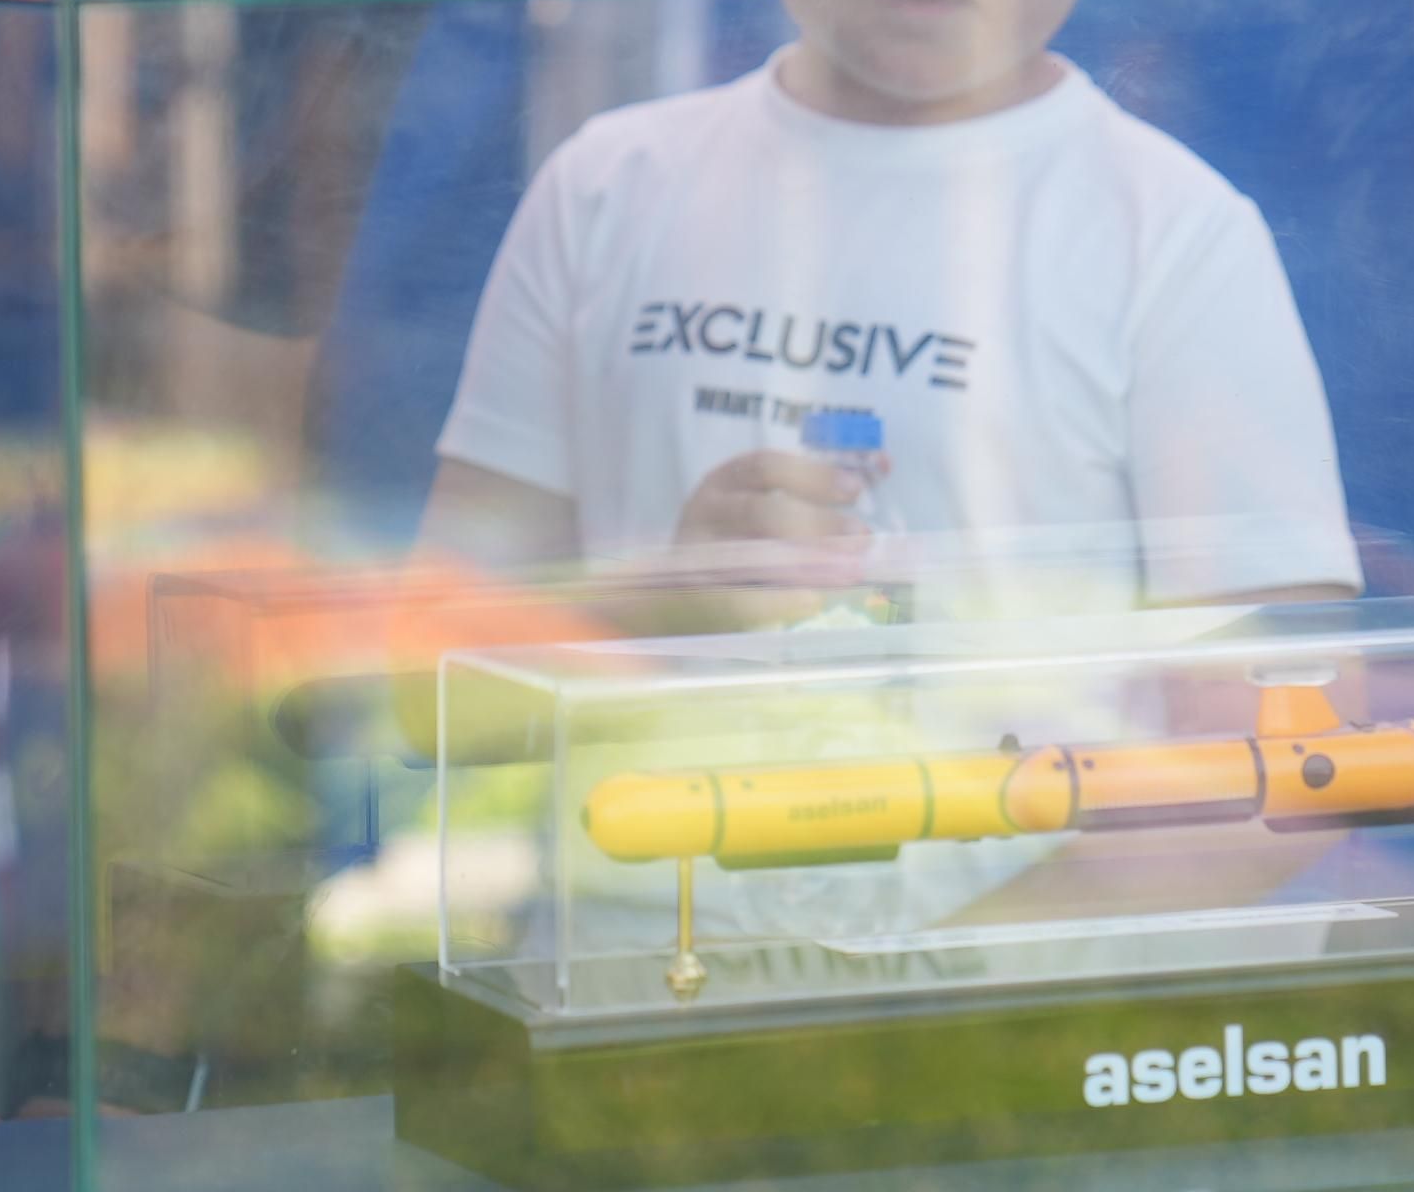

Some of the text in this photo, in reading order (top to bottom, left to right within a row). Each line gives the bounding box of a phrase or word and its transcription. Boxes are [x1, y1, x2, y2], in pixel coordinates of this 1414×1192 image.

[631, 303, 976, 390] EXCLUSIVE
[788, 796, 888, 824] aselsan
[1083, 1023, 1387, 1107] aselsan
